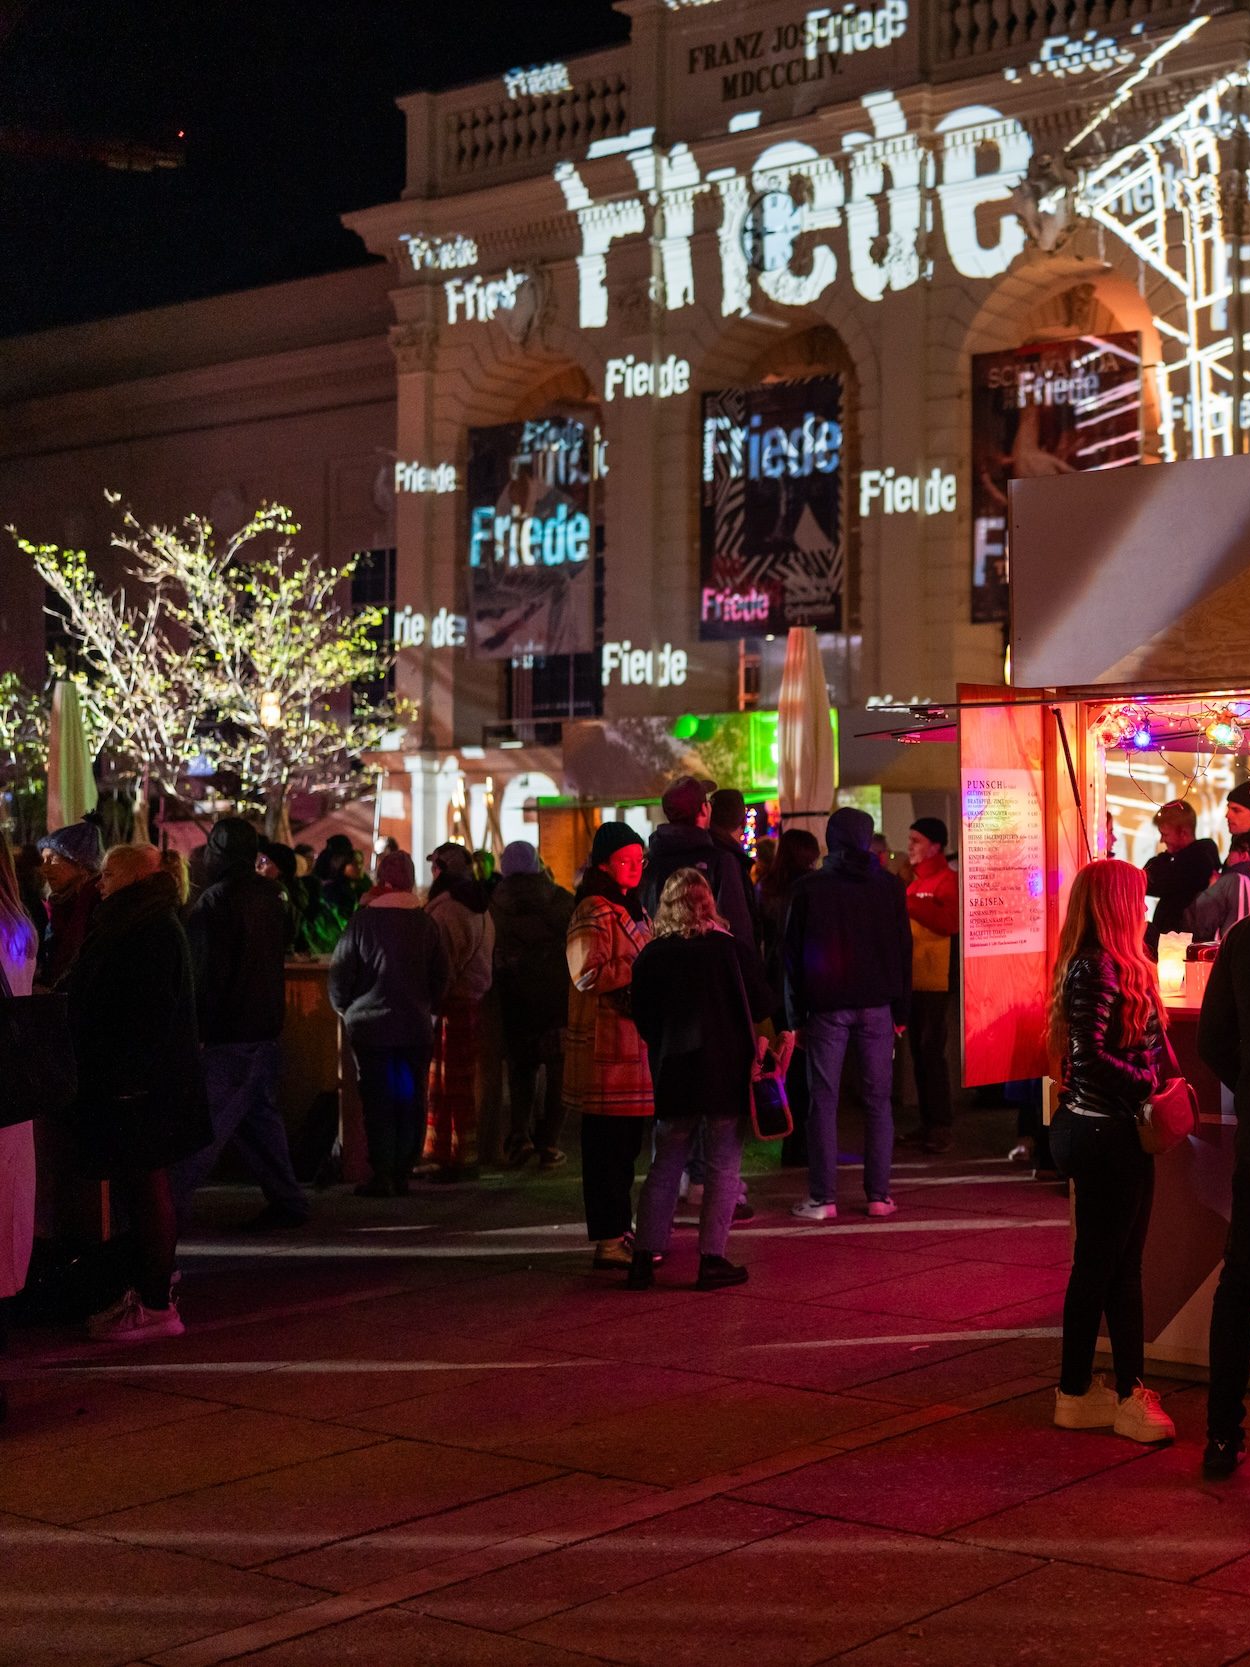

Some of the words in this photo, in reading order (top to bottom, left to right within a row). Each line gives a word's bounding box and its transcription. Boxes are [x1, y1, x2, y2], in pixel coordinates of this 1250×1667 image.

[688, 31, 763, 75] FRANZ
[806, 0, 909, 60] Friede
[555, 86, 1034, 329] Friede
[604, 354, 690, 401] Fiede
[703, 411, 843, 482] Friede
[395, 461, 457, 494] Friede
[859, 466, 957, 518] Fiede
[469, 503, 590, 568] Friede
[394, 605, 467, 649] riede
[702, 586, 769, 621] Friede
[601, 640, 688, 687] Fiede
[967, 780, 1003, 790] PUNSCH
[969, 897, 1004, 907] SPEISEN
